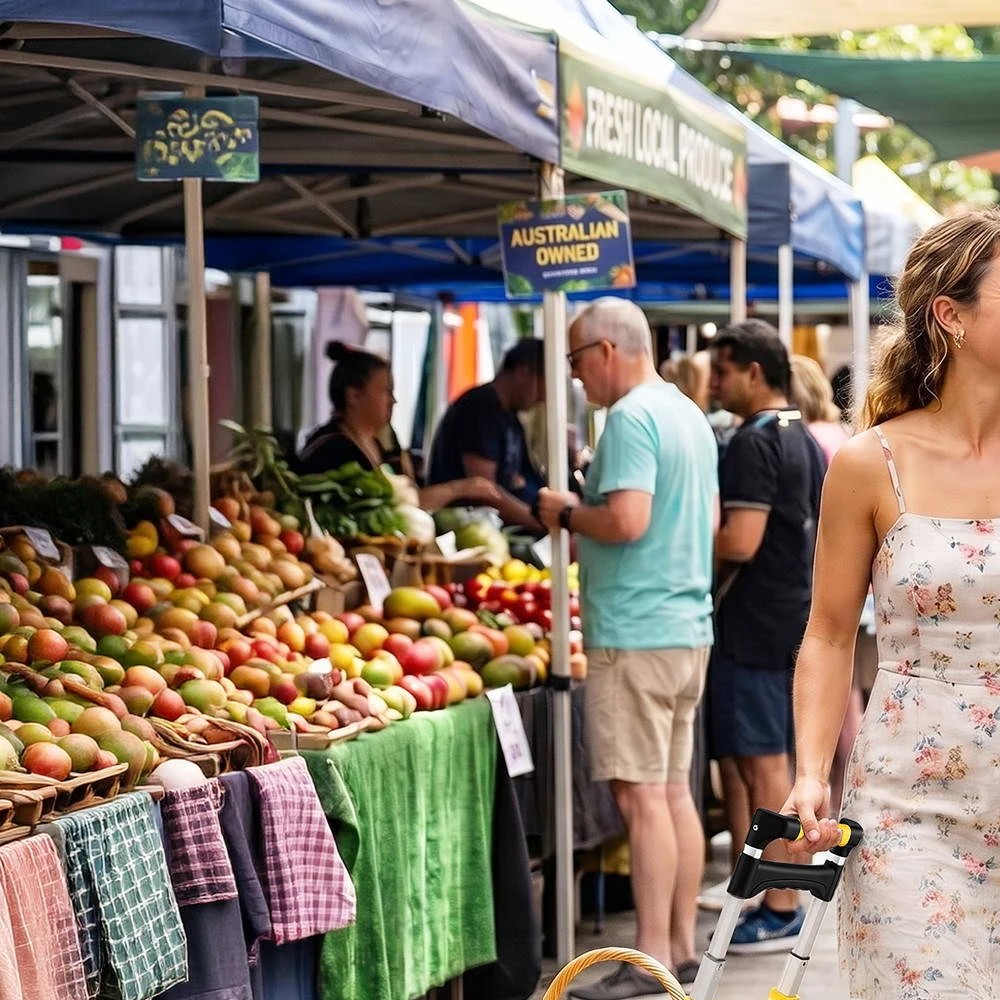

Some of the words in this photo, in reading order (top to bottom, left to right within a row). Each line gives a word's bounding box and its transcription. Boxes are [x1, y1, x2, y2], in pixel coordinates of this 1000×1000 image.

[586, 86, 634, 160] FRESH
[634, 102, 678, 176] LOCAL
[678, 122, 734, 203] PRODUCE
[510, 220, 620, 249] AUSTRALIAN
[535, 242, 600, 267] OWNED
